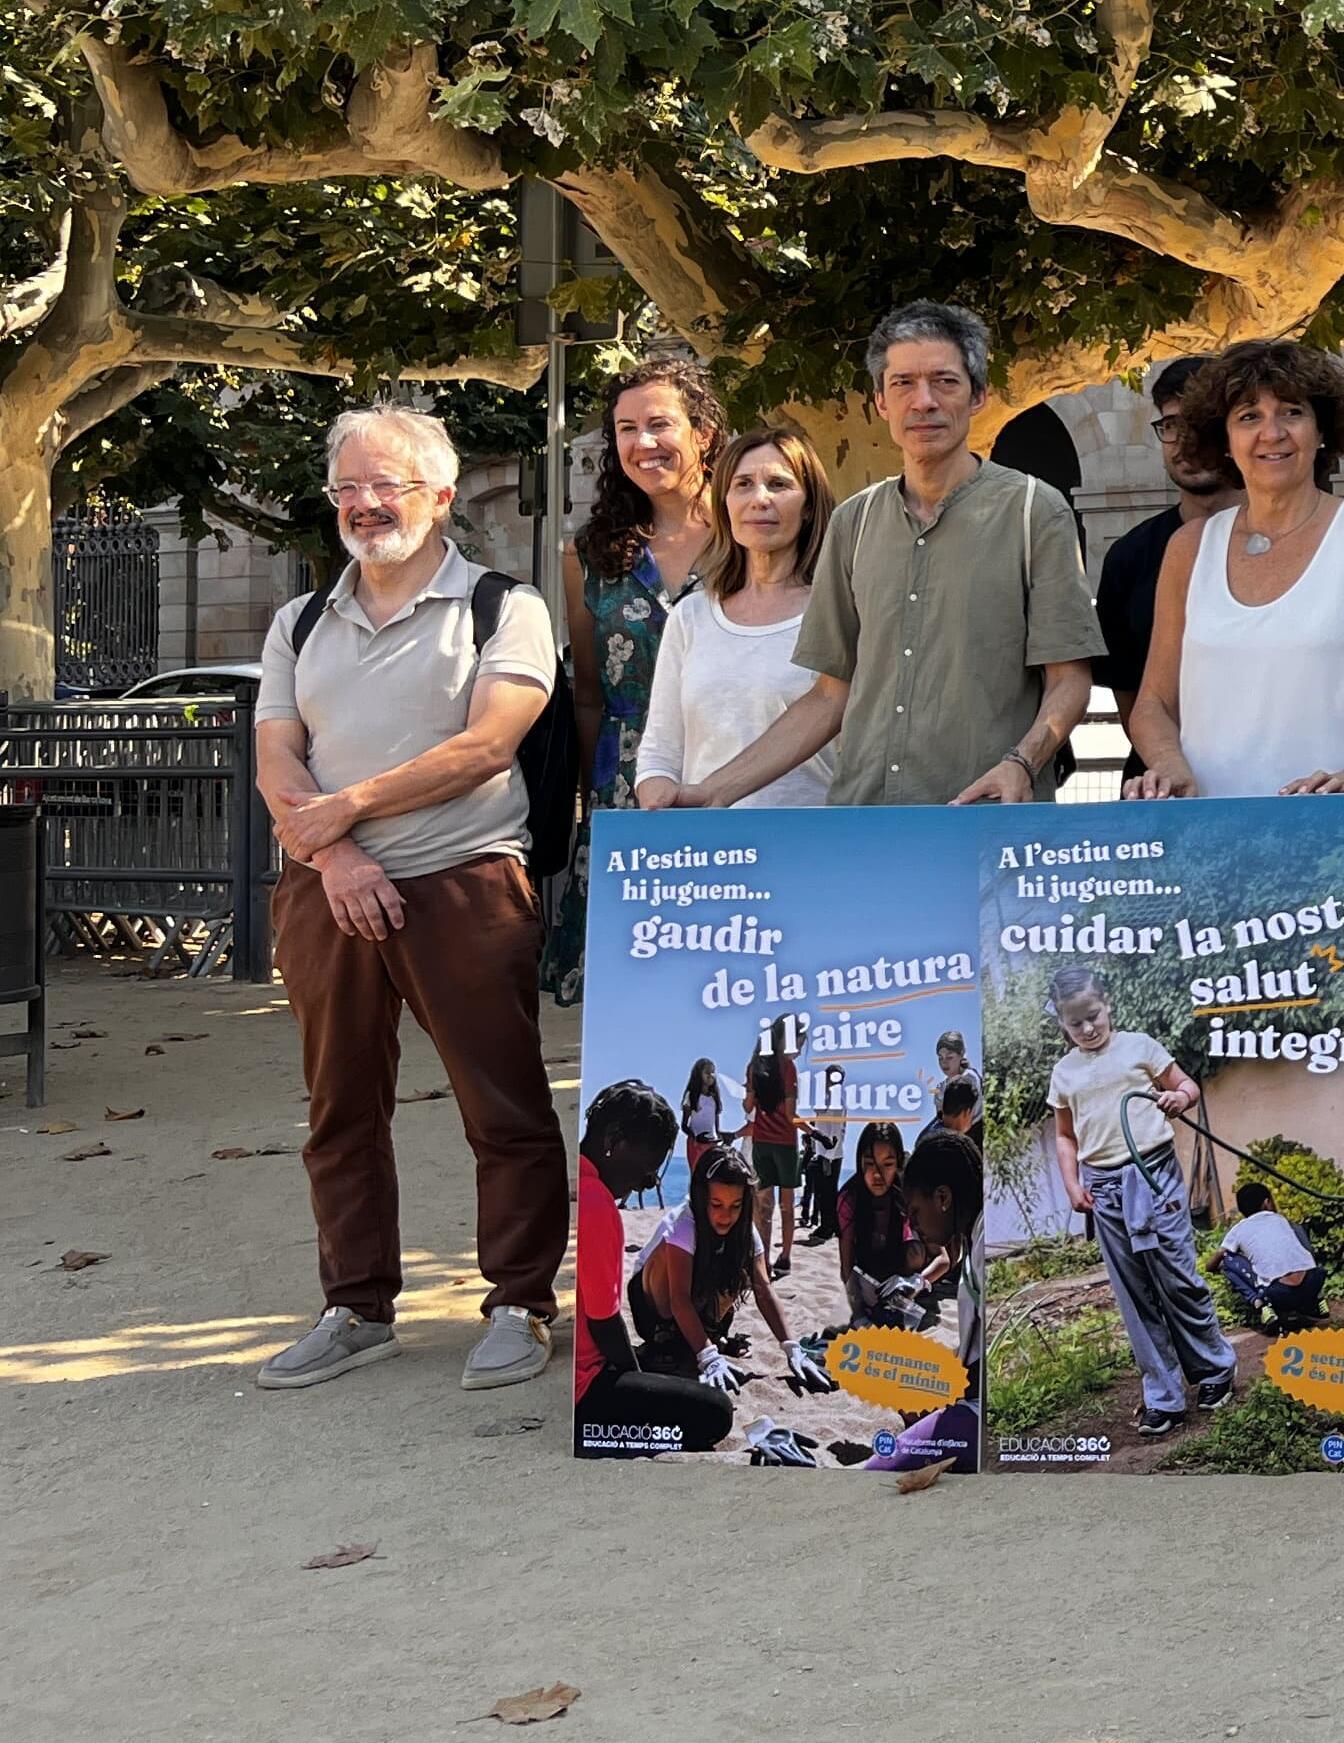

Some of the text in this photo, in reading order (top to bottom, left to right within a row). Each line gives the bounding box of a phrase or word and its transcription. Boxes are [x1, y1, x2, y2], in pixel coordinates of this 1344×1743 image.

[607, 846, 757, 872] A l'estiu ens
[998, 840, 1164, 869] A l'estiu ens
[623, 879, 770, 906] hi juguem...
[1017, 875, 1181, 903] hi juguem...
[630, 914, 782, 958] gaudir
[1000, 914, 1164, 954] cuidar
[1175, 918, 1225, 959] la
[702, 951, 975, 1009] de la natura
[1190, 960, 1317, 1006] salut
[758, 1012, 902, 1056] i l'aire
[797, 1070, 922, 1112] lliure
[839, 1343, 940, 1373] 2 setmanes
[864, 1362, 880, 1377] és
[883, 1367, 897, 1380] el
[1281, 1346, 1304, 1377] 2
[1309, 1366, 1326, 1381] és
[1330, 1370, 1344, 1384] el
